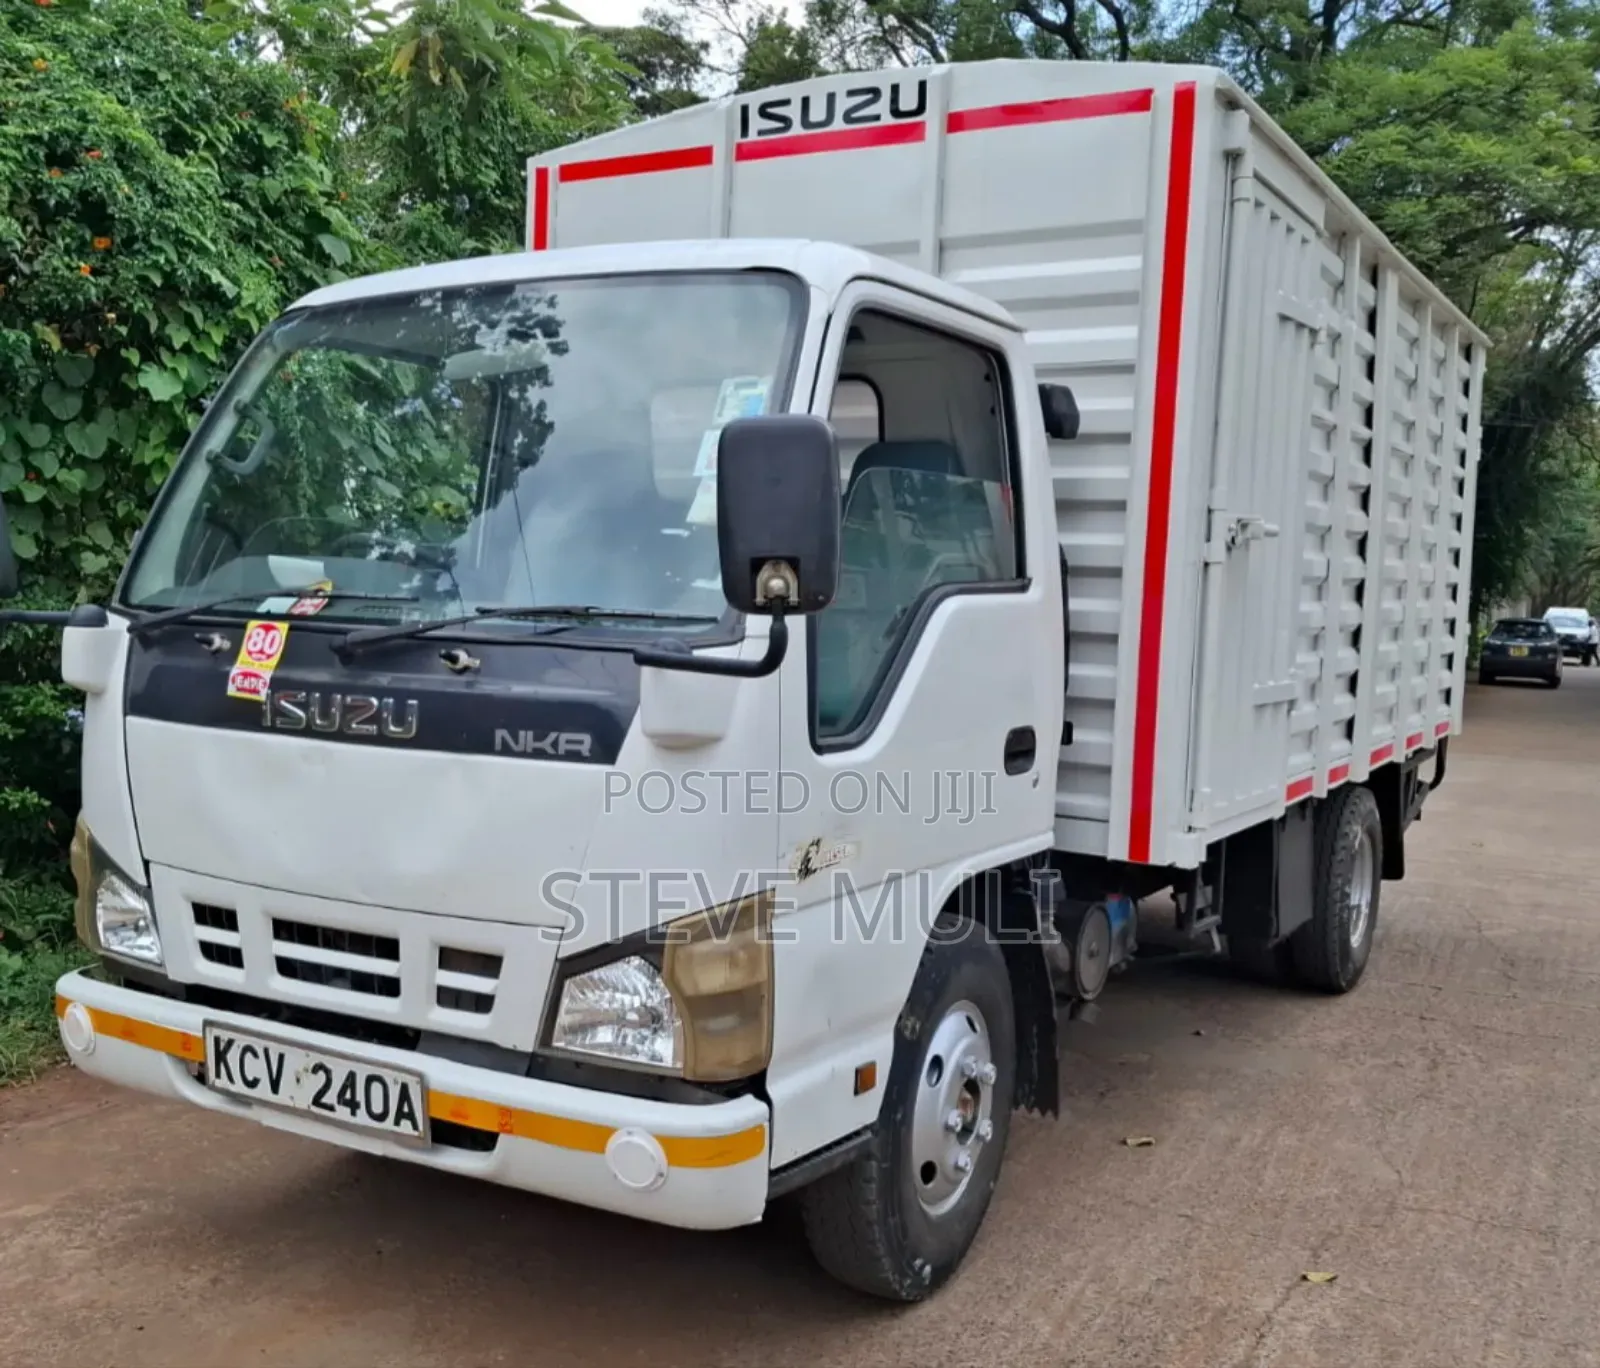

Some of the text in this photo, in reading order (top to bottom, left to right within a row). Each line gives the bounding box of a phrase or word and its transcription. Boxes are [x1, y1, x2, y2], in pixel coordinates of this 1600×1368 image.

[740, 79, 927, 138] ISUZU
[247, 627, 282, 655] 80
[262, 690, 419, 739] ISUZU
[494, 728, 592, 758] NKR
[213, 1035, 420, 1132] KCV 240A
